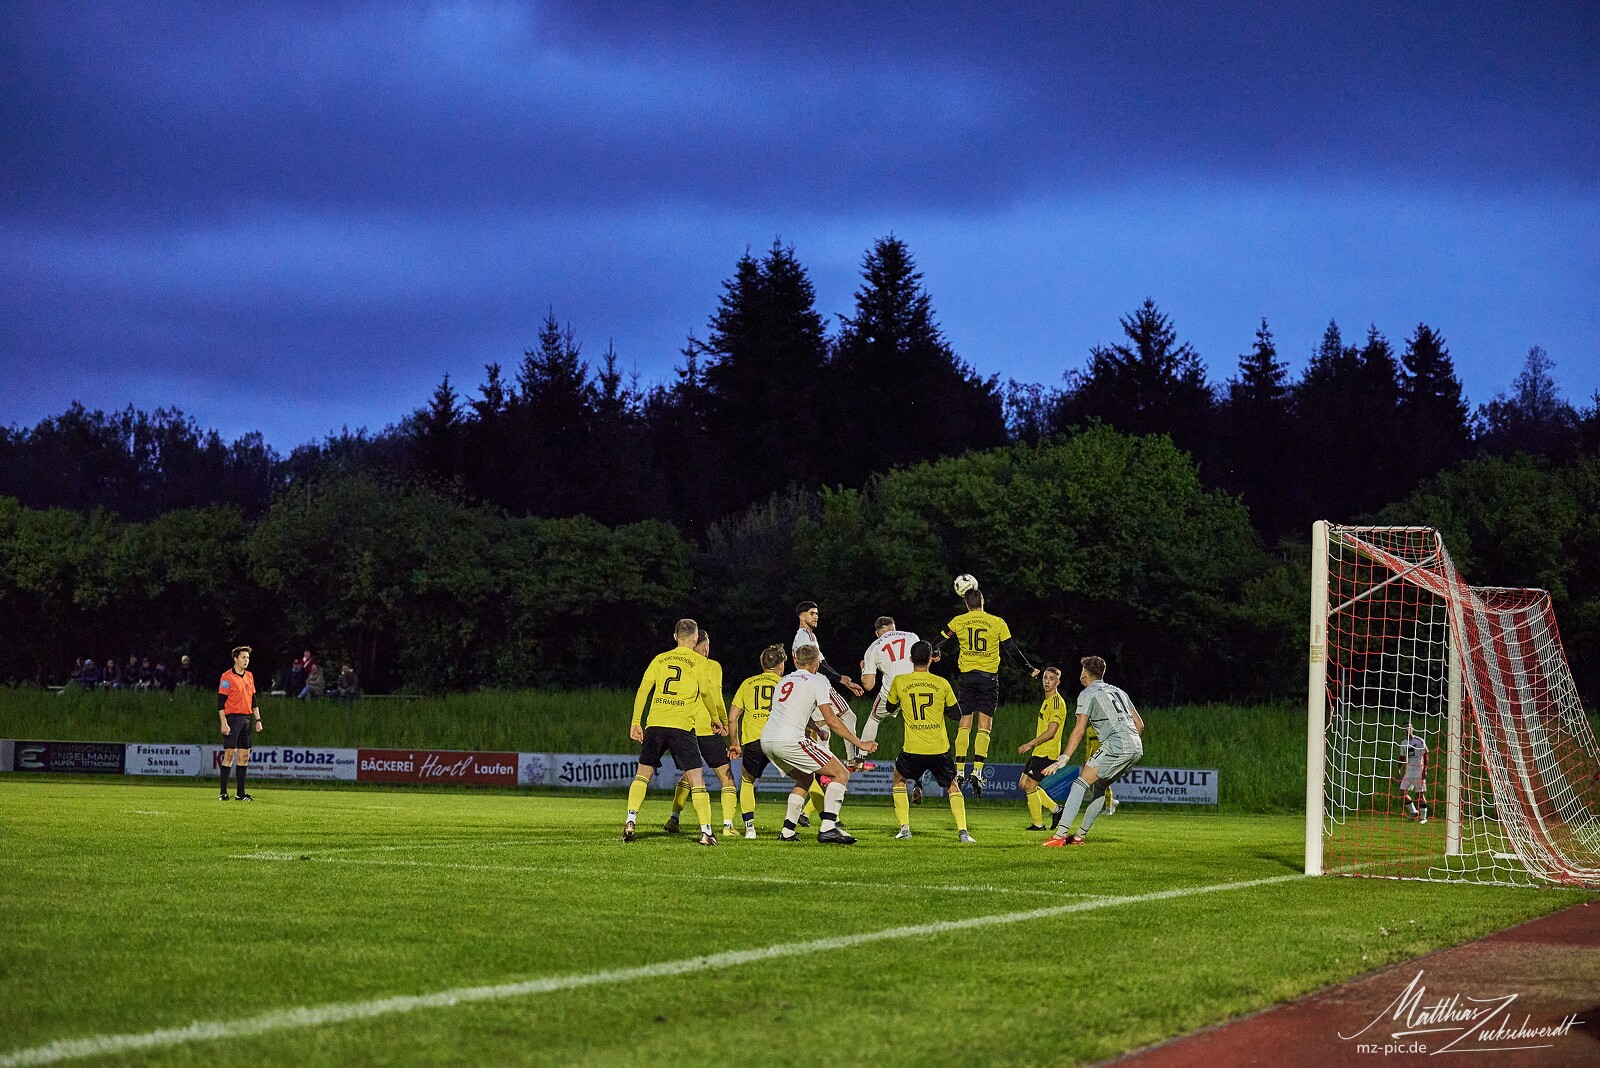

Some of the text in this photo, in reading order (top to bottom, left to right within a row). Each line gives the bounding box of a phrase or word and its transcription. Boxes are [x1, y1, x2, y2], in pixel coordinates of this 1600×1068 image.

[881, 638, 906, 662] 17
[967, 628, 988, 651] 16
[662, 664, 682, 695] 2
[754, 685, 776, 712] 19
[778, 681, 794, 703] 9
[909, 693, 934, 720] 17
[51, 752, 120, 761] ENGELMANN
[248, 750, 277, 763] urt
[283, 750, 335, 764] Bobaz
[419, 754, 473, 778] Hartl
[475, 763, 514, 775] Laufen
[1139, 786, 1187, 795] WAGNER
